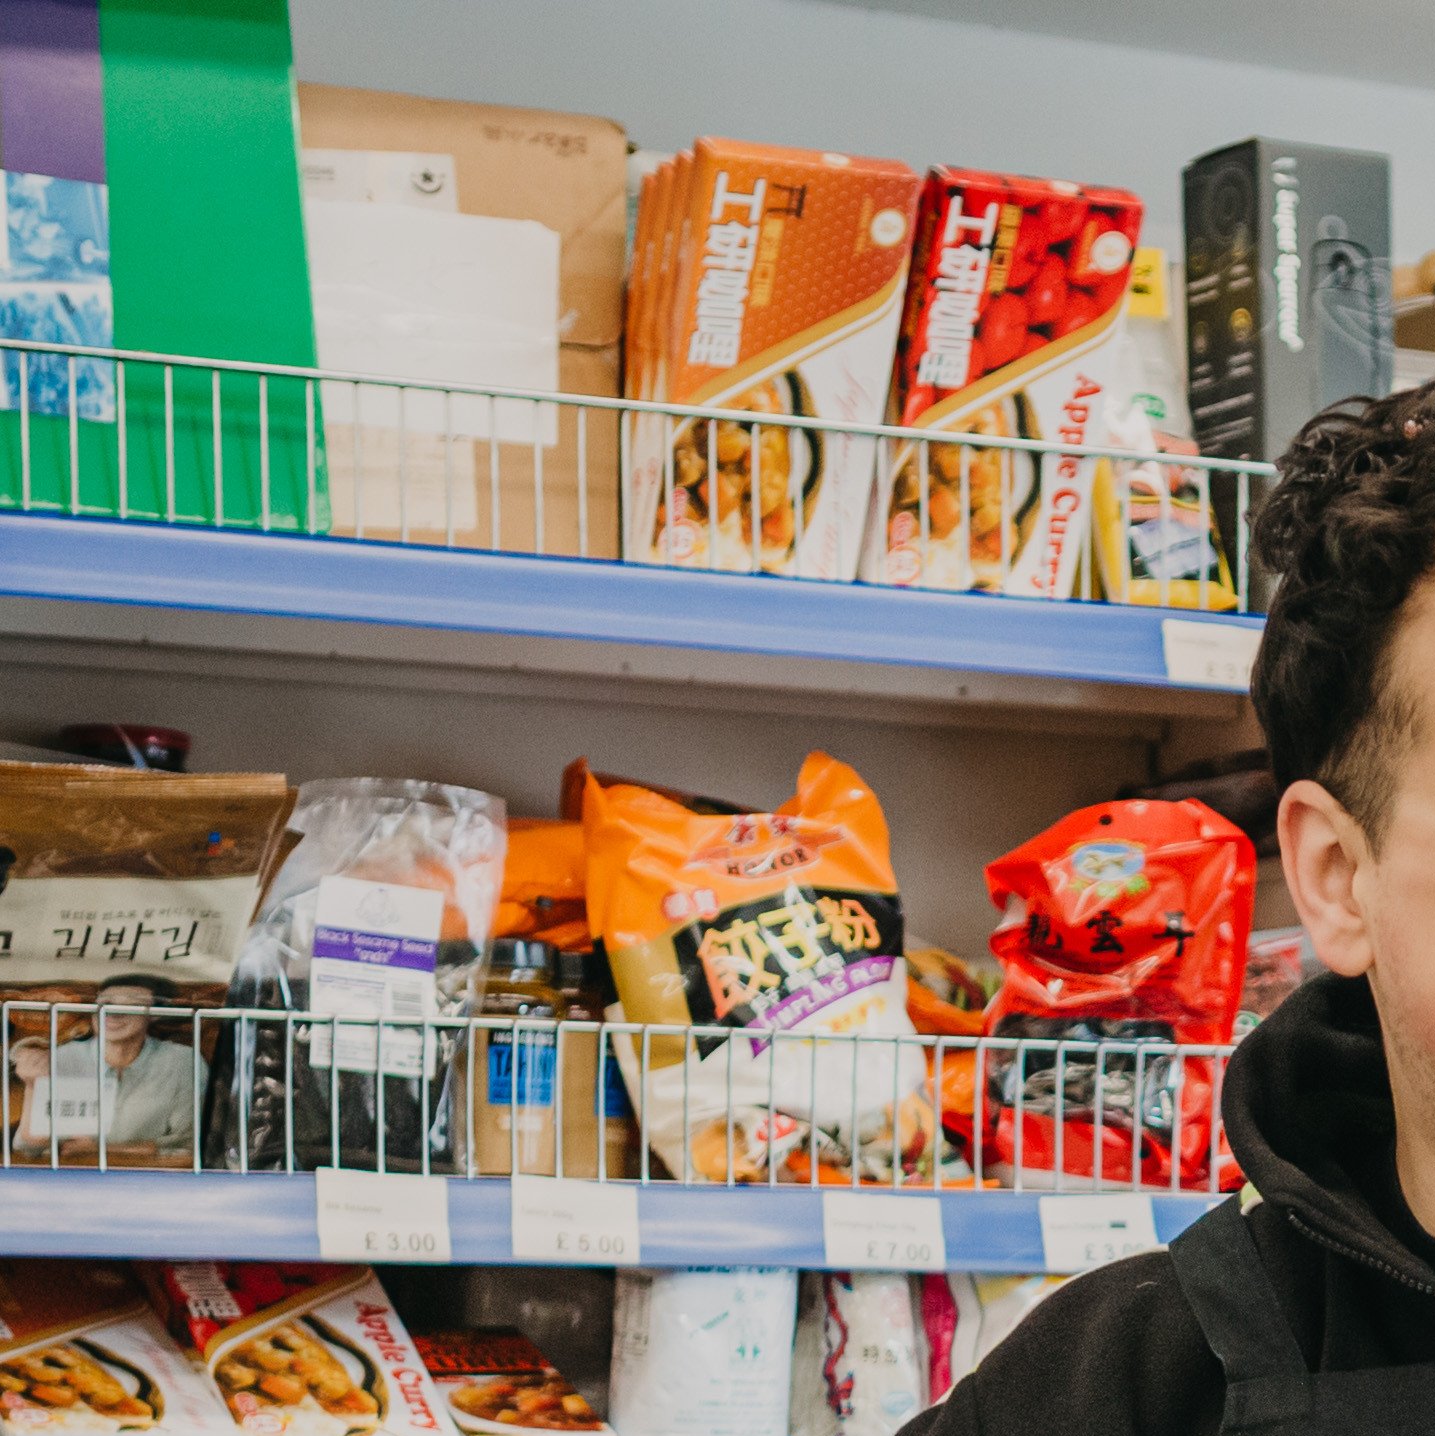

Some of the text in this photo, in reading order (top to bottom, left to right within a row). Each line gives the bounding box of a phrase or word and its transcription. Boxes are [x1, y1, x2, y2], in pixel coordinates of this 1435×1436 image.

[687, 170, 767, 367] 工研咖哩
[917, 196, 998, 389] 工研咖哩
[53, 920, 198, 960] 김밥김
[387, 1231, 436, 1253] 3.00
[578, 1233, 624, 1255] 5.00
[887, 1242, 931, 1262] 7.00
[1104, 1242, 1145, 1261] 30
[353, 1300, 441, 1431] Apple Curry
